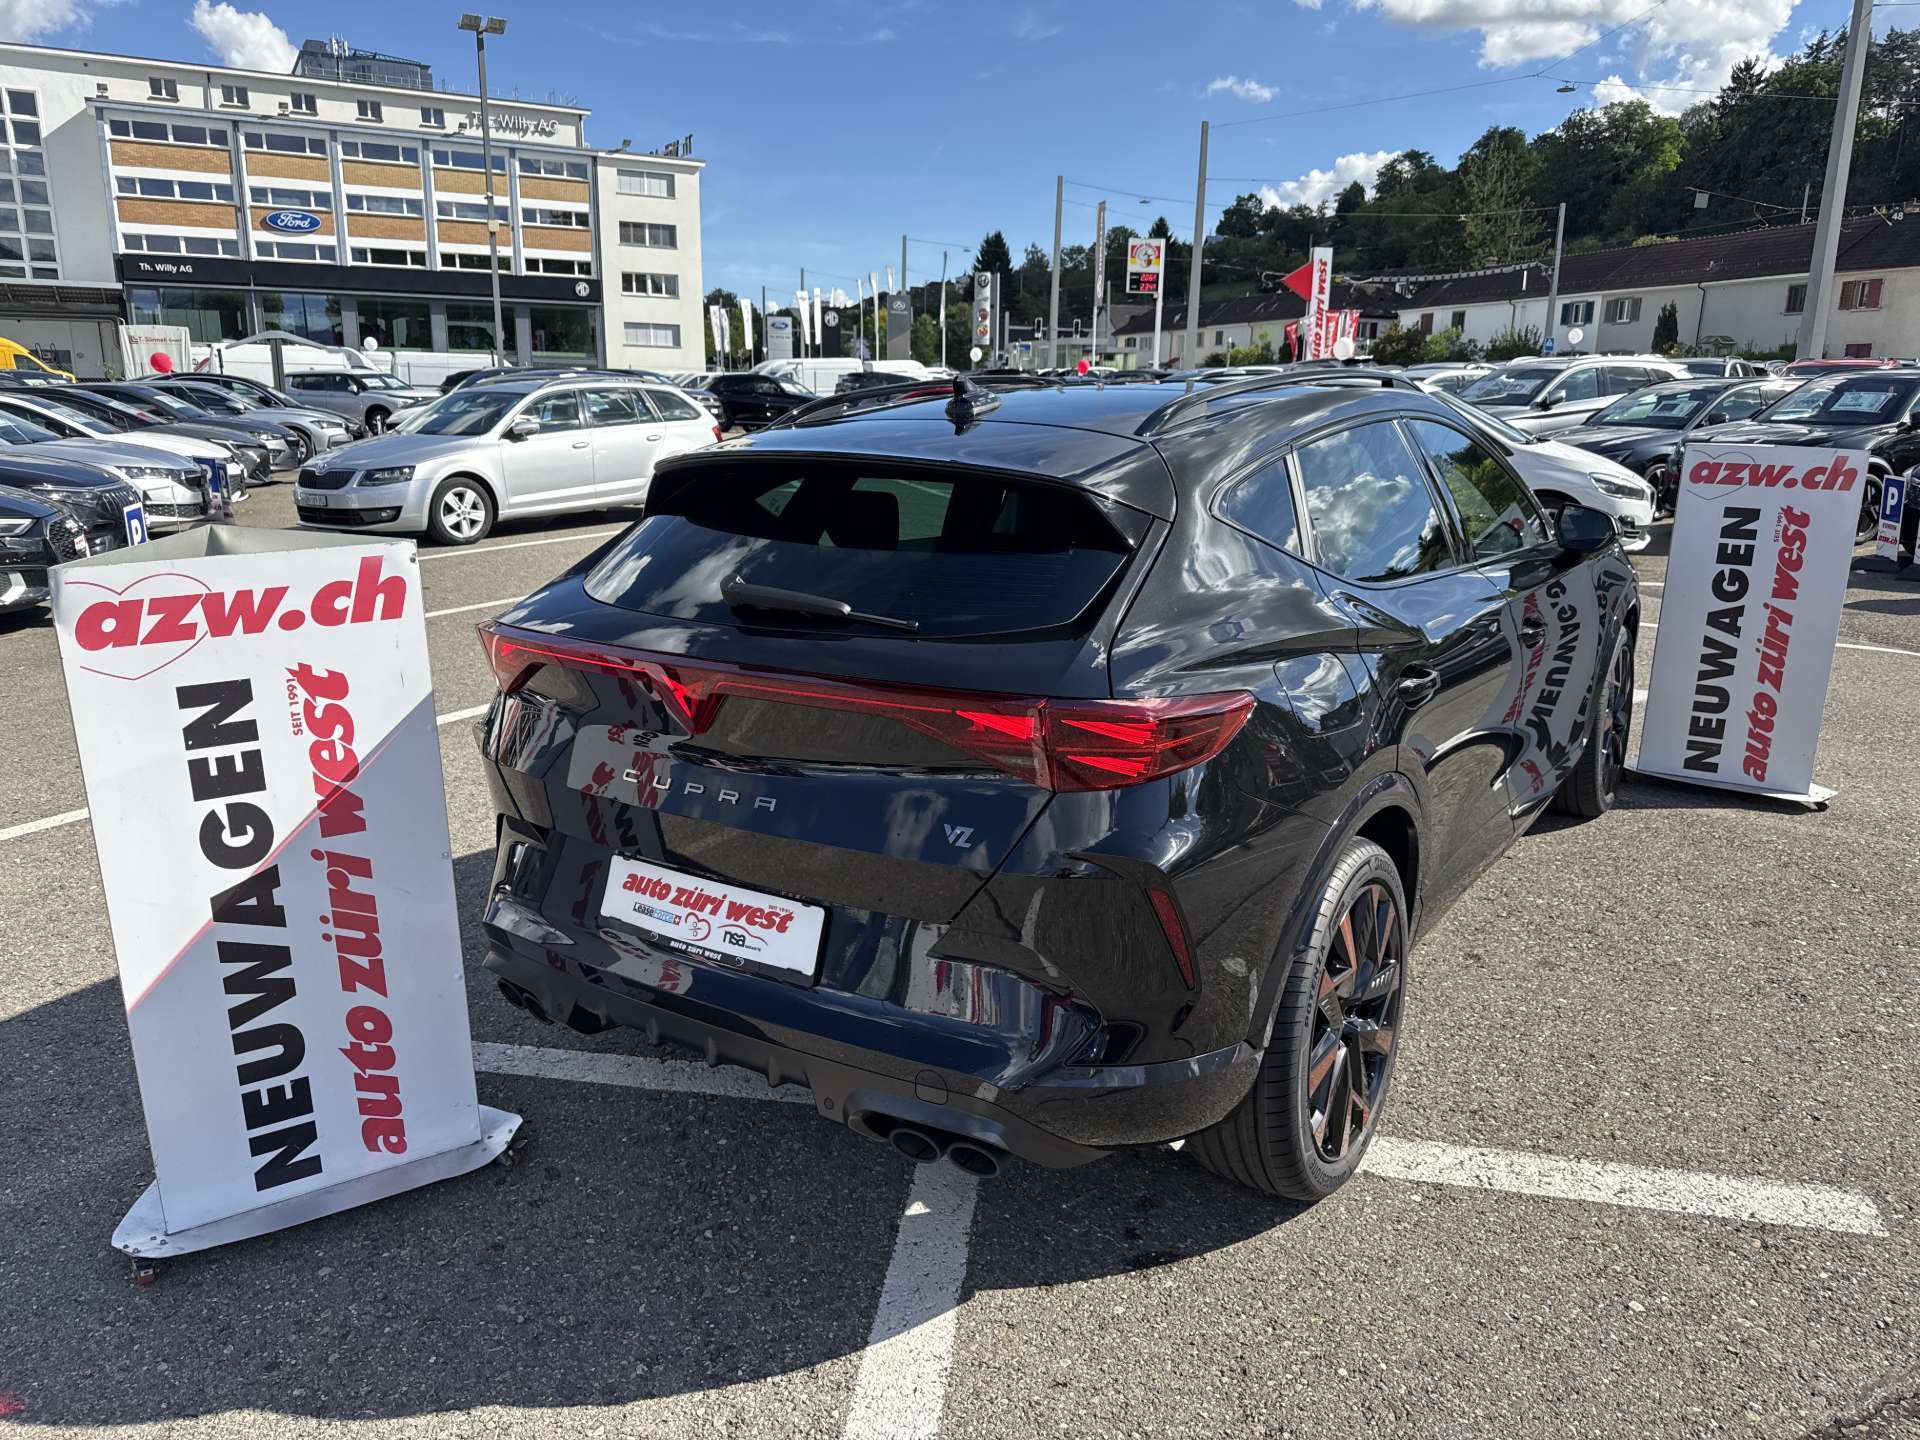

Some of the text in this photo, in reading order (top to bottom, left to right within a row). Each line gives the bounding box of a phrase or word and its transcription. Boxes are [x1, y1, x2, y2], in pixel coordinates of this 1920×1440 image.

[538, 118, 560, 133] AG
[1891, 211, 1904, 220] 48
[138, 262, 193, 274] Th. Willy AG
[1317, 258, 1327, 295] west
[1688, 455, 1859, 492] azw.ch
[1885, 486, 1898, 515] P
[130, 518, 142, 546] P
[74, 555, 407, 652] azw.ch
[1683, 506, 1761, 774] NEUWAGEN
[1742, 504, 1811, 783] auto züri west
[287, 677, 304, 736] SEIT 1991
[622, 768, 777, 813] CUPRA
[943, 823, 975, 848] VZ
[285, 661, 408, 1156] auto züri west
[622, 872, 795, 934] auto züri west
[175, 678, 323, 1192] NEUWAGEN
[669, 940, 723, 961] auto züri west
[723, 929, 746, 947] nsa
